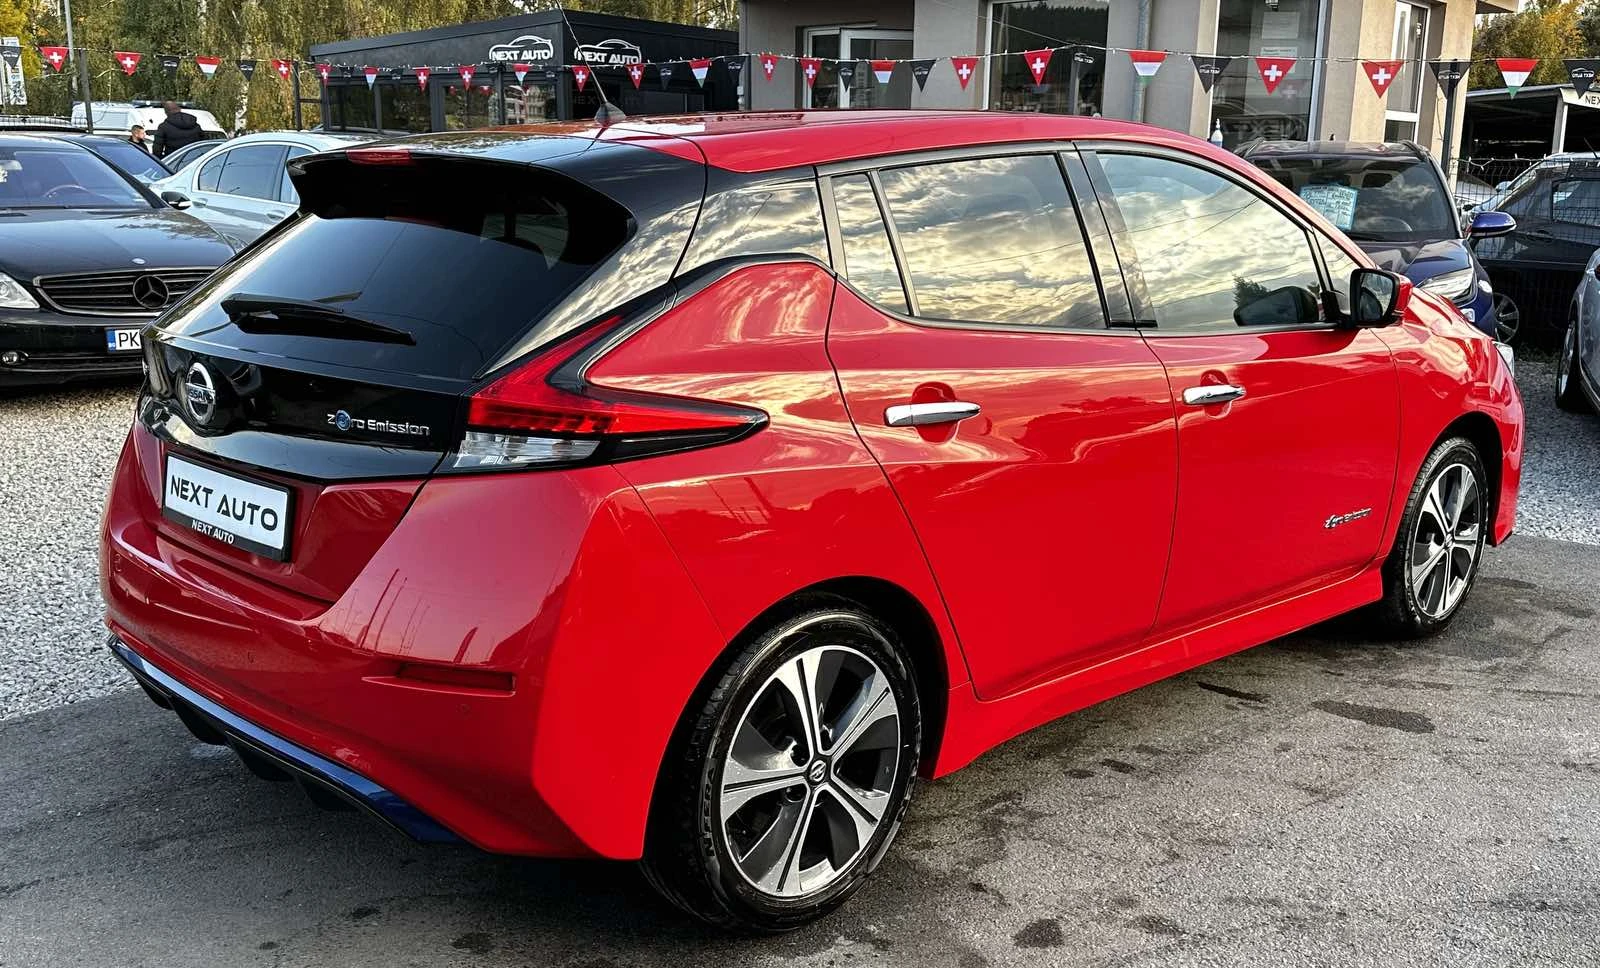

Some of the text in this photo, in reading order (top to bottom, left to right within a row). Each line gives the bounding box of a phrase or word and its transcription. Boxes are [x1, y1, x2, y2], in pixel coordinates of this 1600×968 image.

[492, 49, 550, 61] NEXT AUTO
[577, 50, 640, 65] NEXT AUTO
[118, 331, 140, 348] PK
[367, 419, 430, 436] Emission
[170, 474, 278, 532] NEXT AUTO
[191, 519, 235, 545] NEXT AUTO
